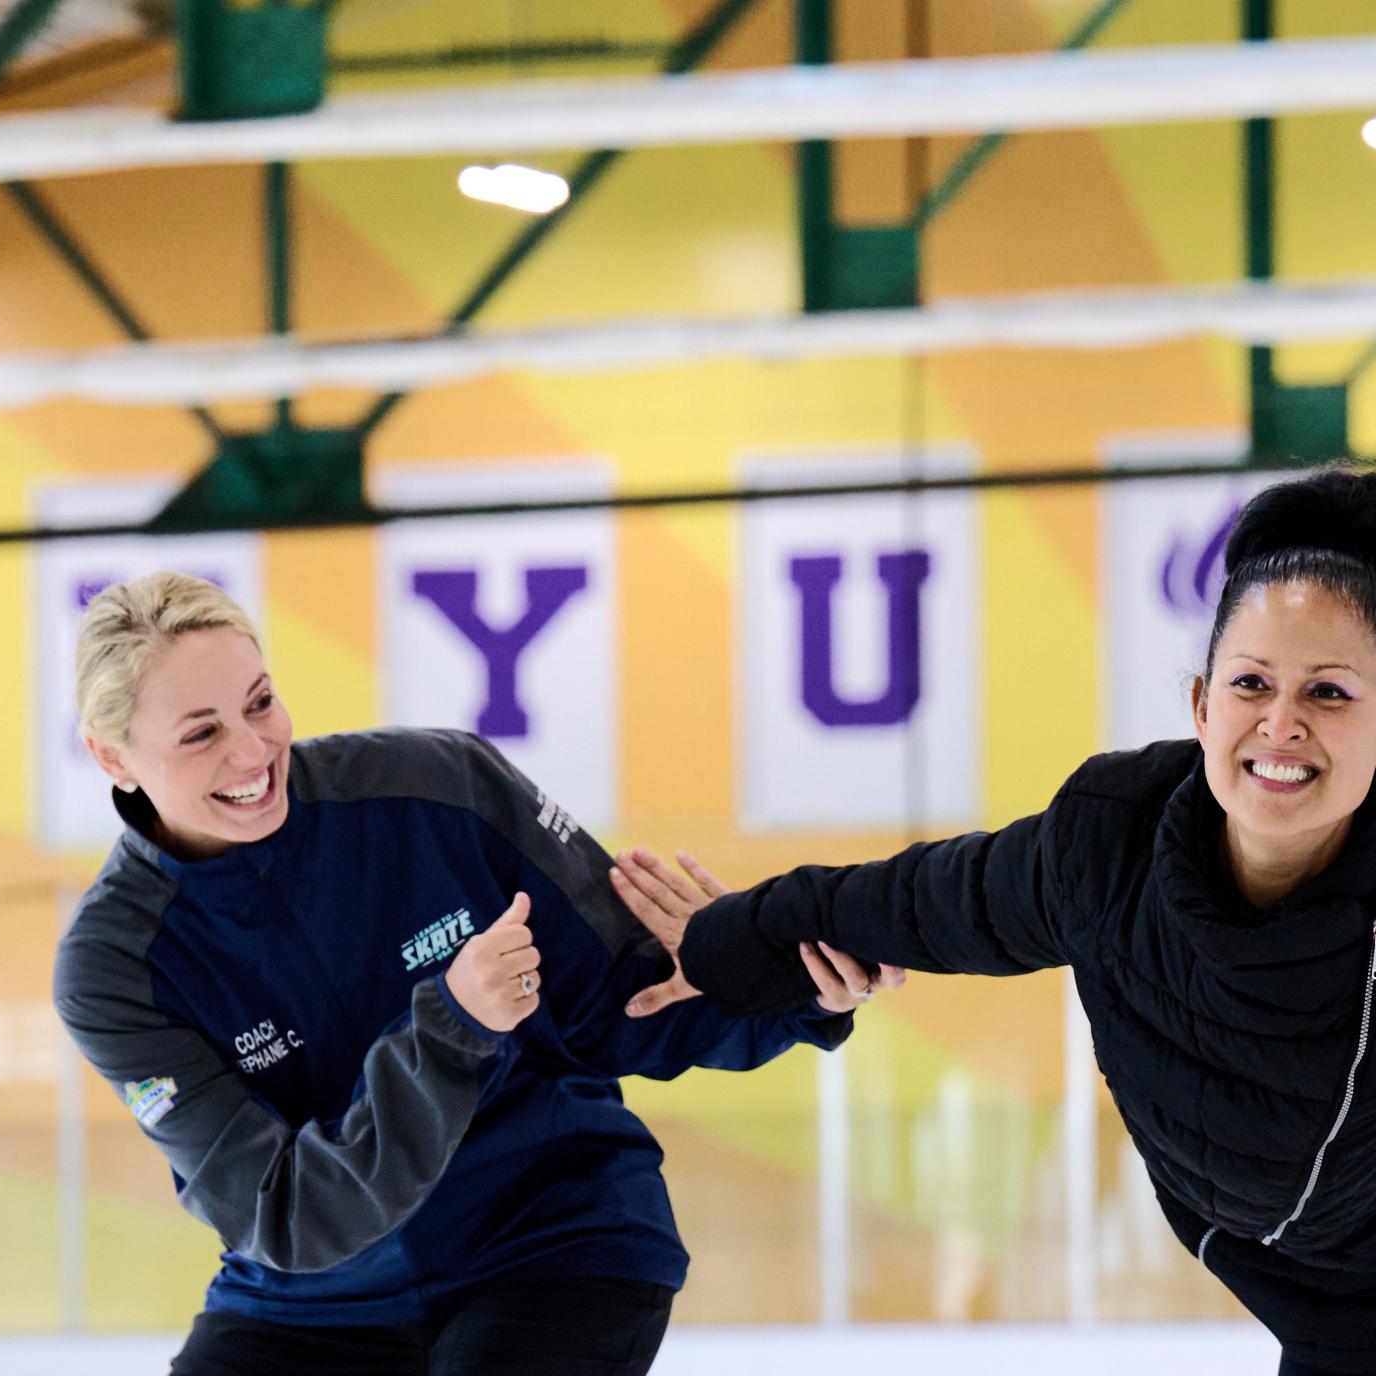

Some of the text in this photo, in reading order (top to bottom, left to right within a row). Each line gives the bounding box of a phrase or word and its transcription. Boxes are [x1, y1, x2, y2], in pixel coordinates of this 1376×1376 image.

[413, 566, 587, 738] Y
[789, 550, 930, 728] U
[401, 909, 475, 971] SKATE
[414, 920, 442, 941] LEARN
[234, 1018, 278, 1055] COACH
